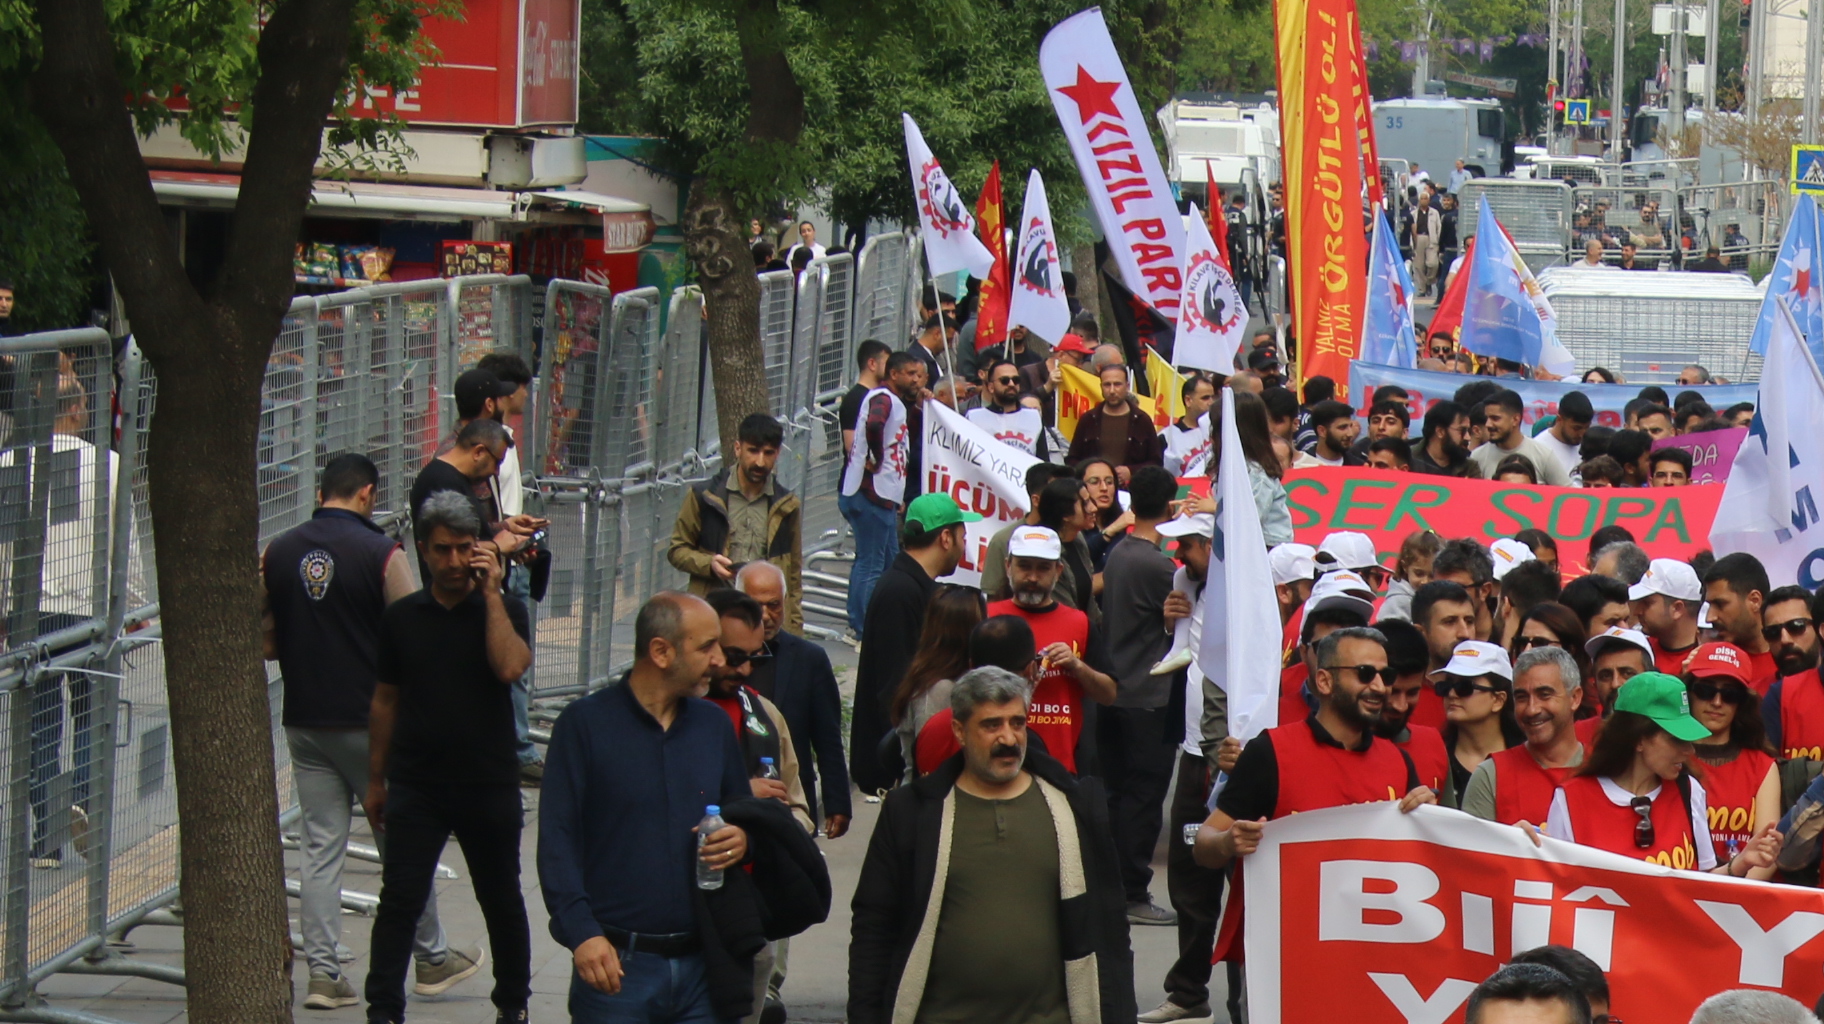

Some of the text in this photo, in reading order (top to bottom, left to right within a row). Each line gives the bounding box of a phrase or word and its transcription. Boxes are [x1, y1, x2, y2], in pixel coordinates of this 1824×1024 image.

[1385, 116, 1403, 129] 35
[1314, 93, 1349, 293] ÖRGÜTLÜ
[1333, 304, 1354, 358] OLMA
[1285, 478, 1451, 532] SER
[1482, 488, 1692, 544] SOPA
[1715, 646, 1737, 658] DİSK
